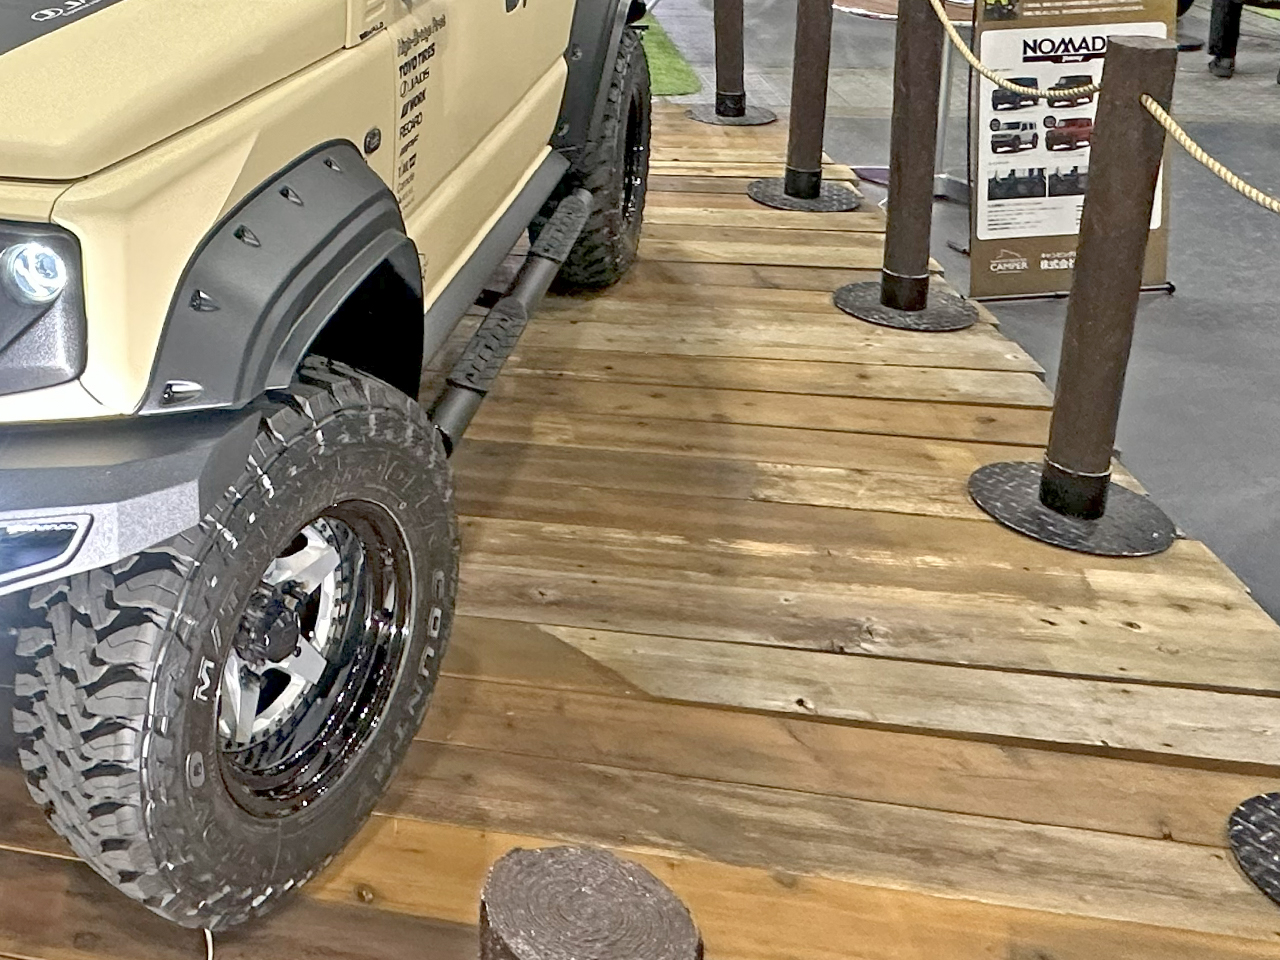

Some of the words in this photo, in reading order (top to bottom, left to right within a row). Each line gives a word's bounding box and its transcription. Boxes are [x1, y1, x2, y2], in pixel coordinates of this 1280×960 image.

[1023, 36, 1106, 55] NOMAD
[399, 55, 417, 79] TOYO
[417, 42, 436, 67] TIRES
[400, 112, 422, 140] RECARO
[990, 261, 1028, 271] CAMPER
